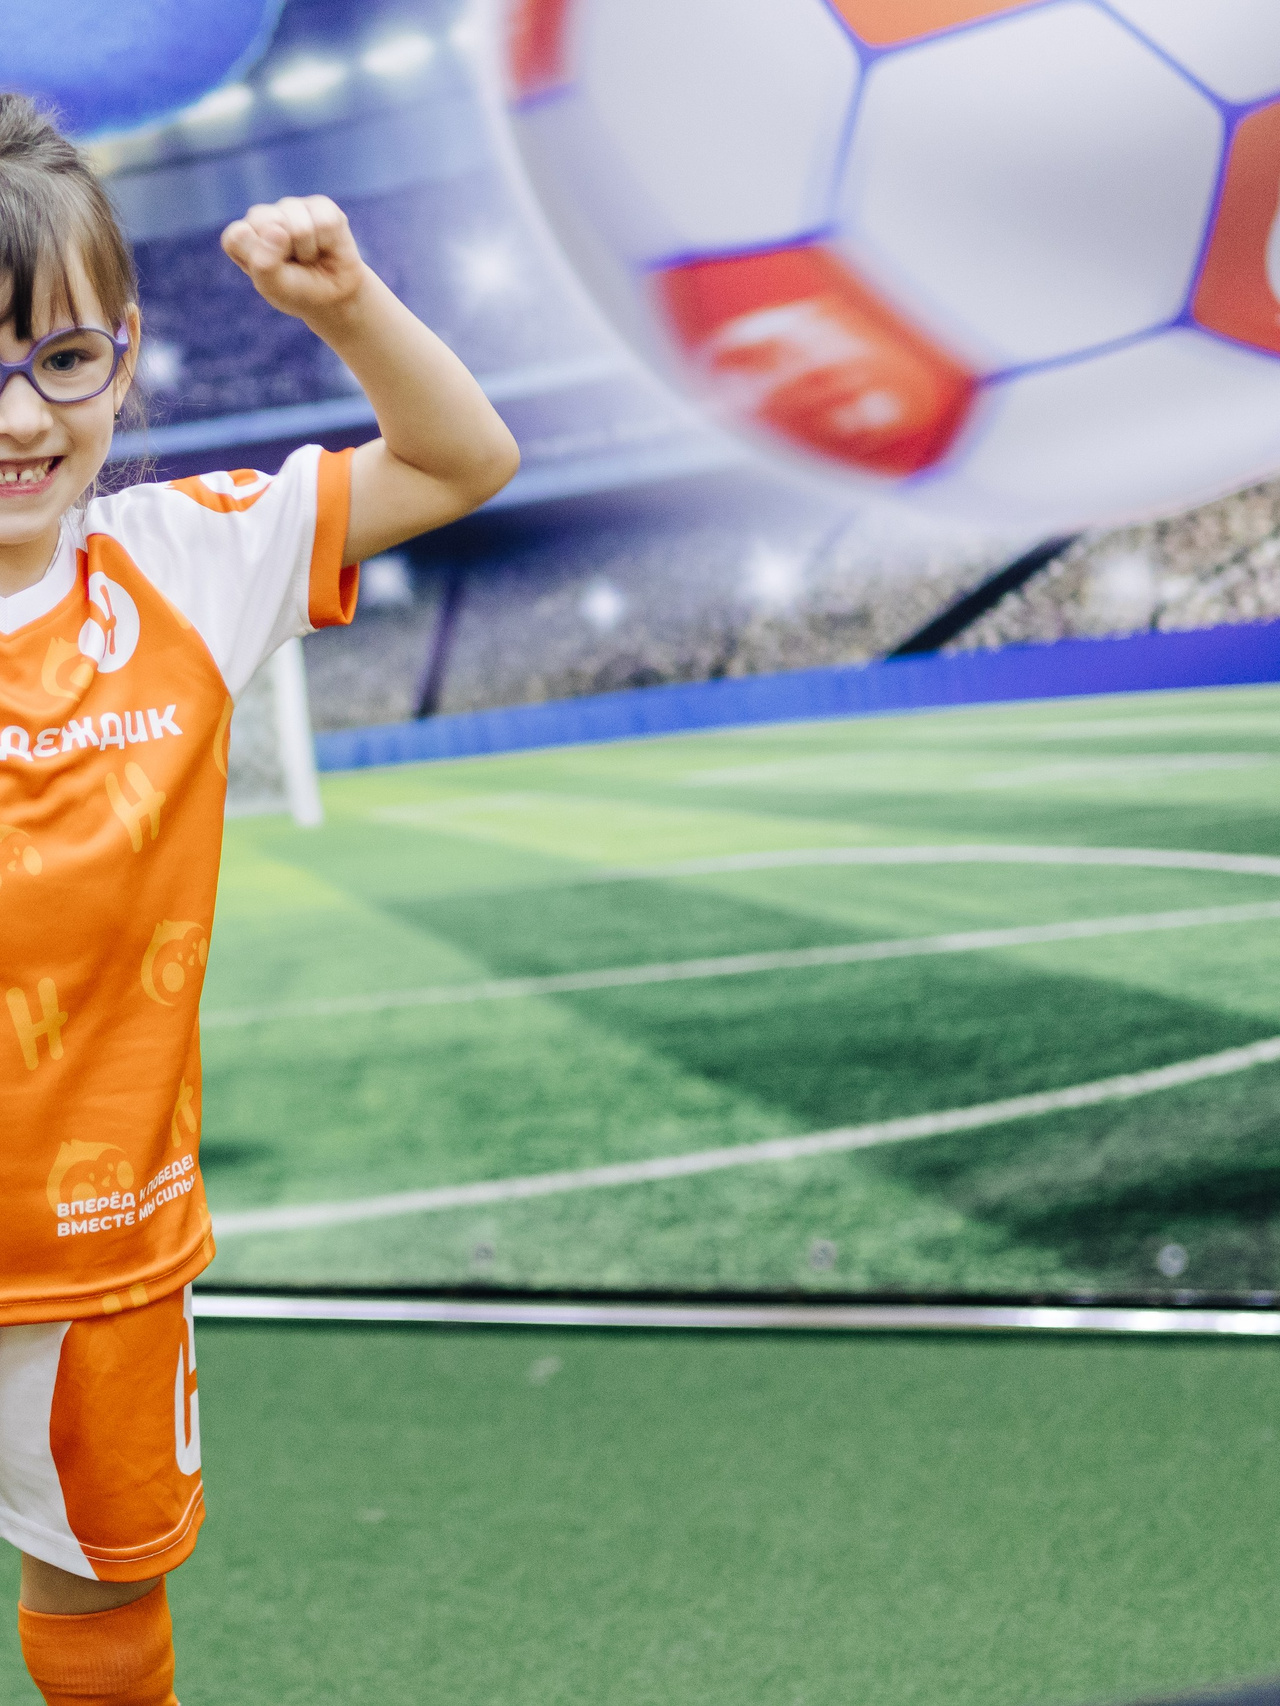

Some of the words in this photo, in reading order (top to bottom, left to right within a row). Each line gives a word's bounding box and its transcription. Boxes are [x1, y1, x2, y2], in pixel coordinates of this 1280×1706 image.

[57, 1191, 136, 1218] ВПЕРЁД
[139, 1186, 147, 1203] К
[57, 1211, 136, 1237] ВМЕСТЕ
[139, 1197, 156, 1221] МЫ
